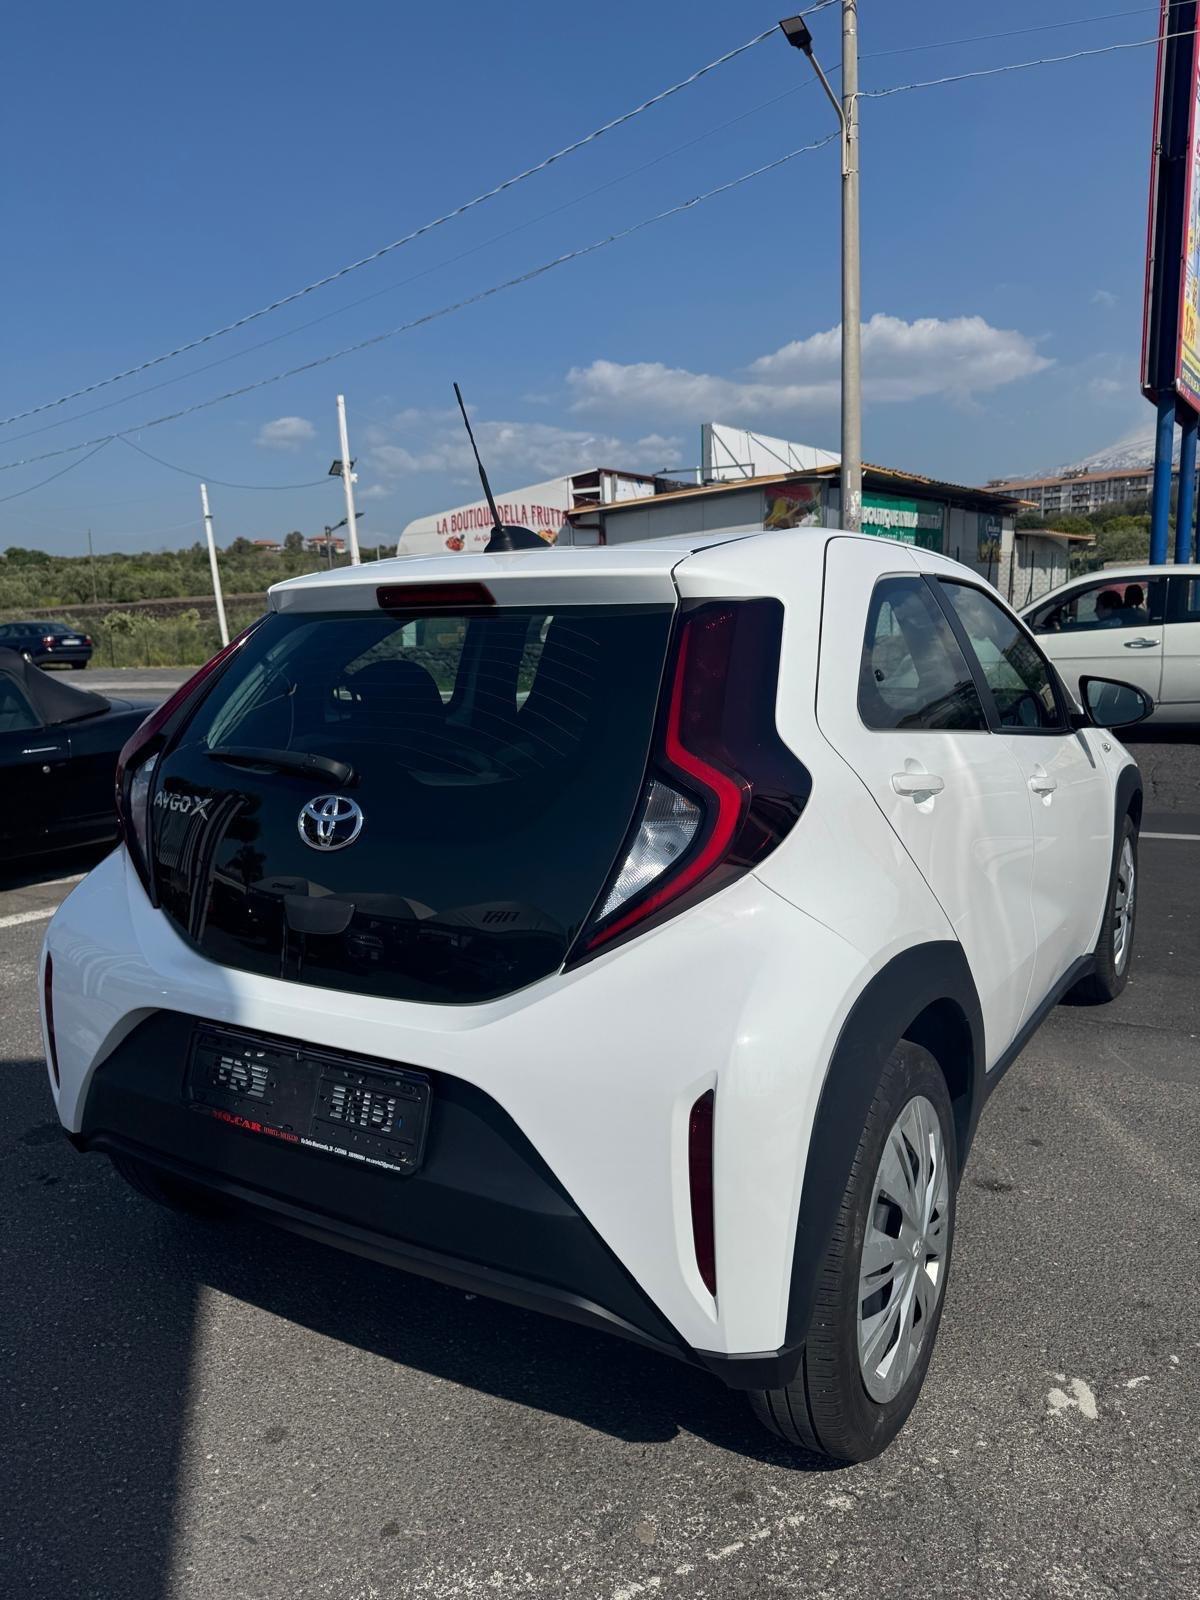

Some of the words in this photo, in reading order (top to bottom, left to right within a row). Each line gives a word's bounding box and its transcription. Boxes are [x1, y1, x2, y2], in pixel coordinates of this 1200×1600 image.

[436, 518, 449, 535] LA
[499, 504, 528, 525] DELLA
[531, 505, 568, 527] FRUTTA
